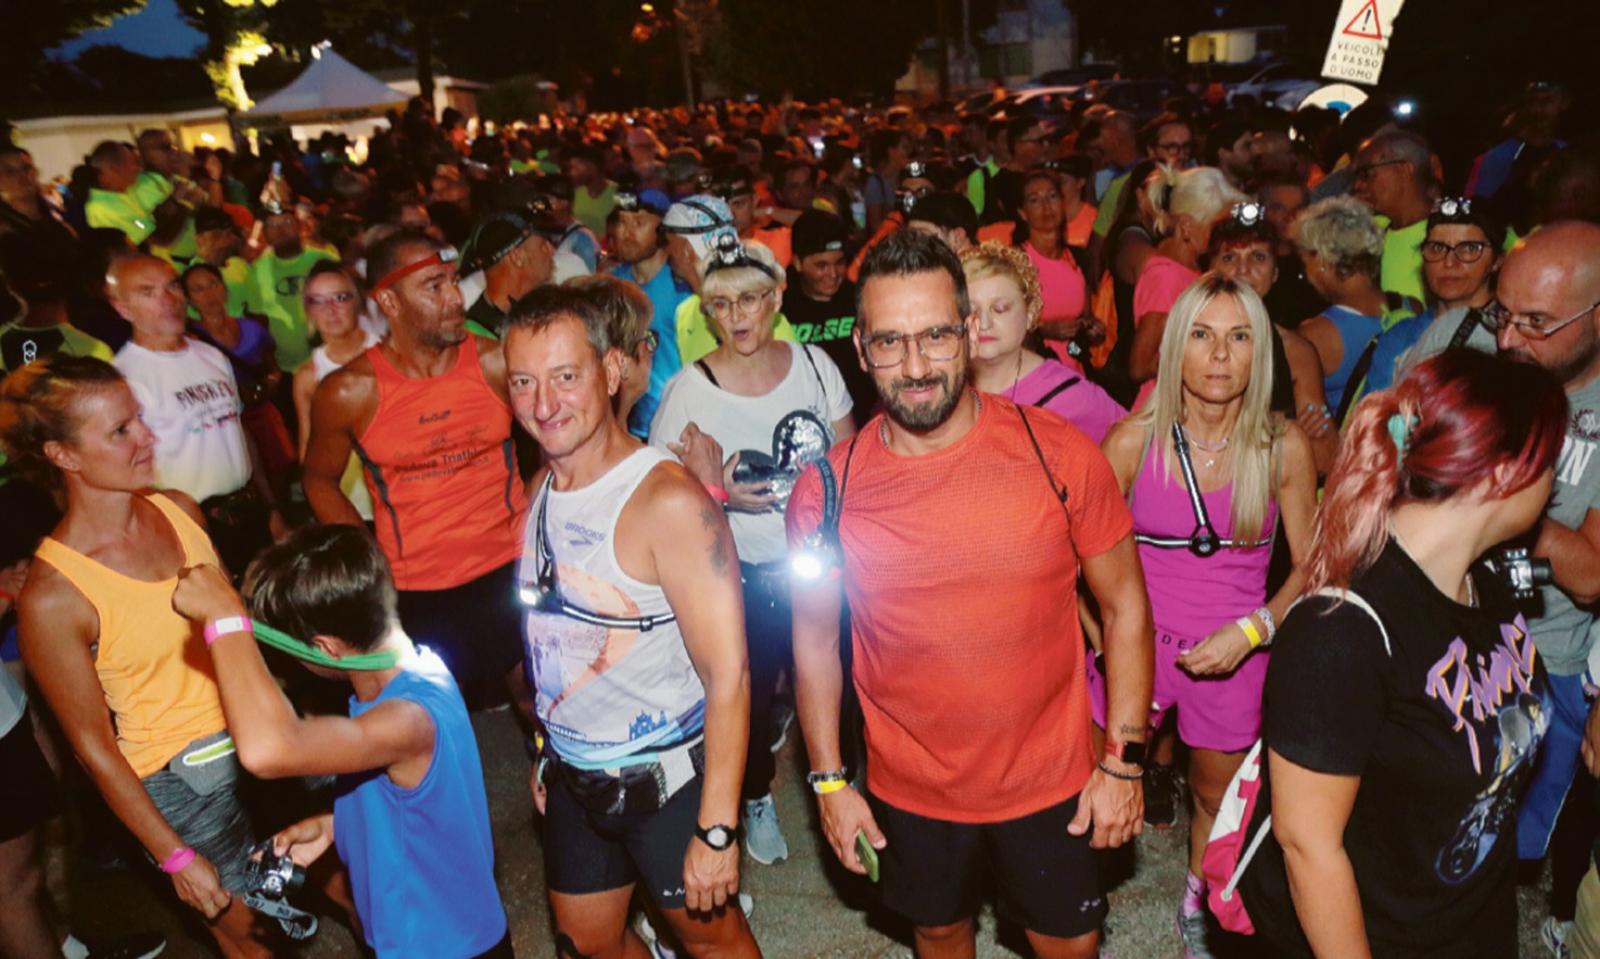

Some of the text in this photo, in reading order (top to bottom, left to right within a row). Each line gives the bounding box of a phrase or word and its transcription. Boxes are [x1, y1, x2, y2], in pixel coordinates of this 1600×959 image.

[1342, 54, 1380, 68] PASSO
[441, 447, 489, 465] Triathl
[564, 522, 606, 541] BROOKS
